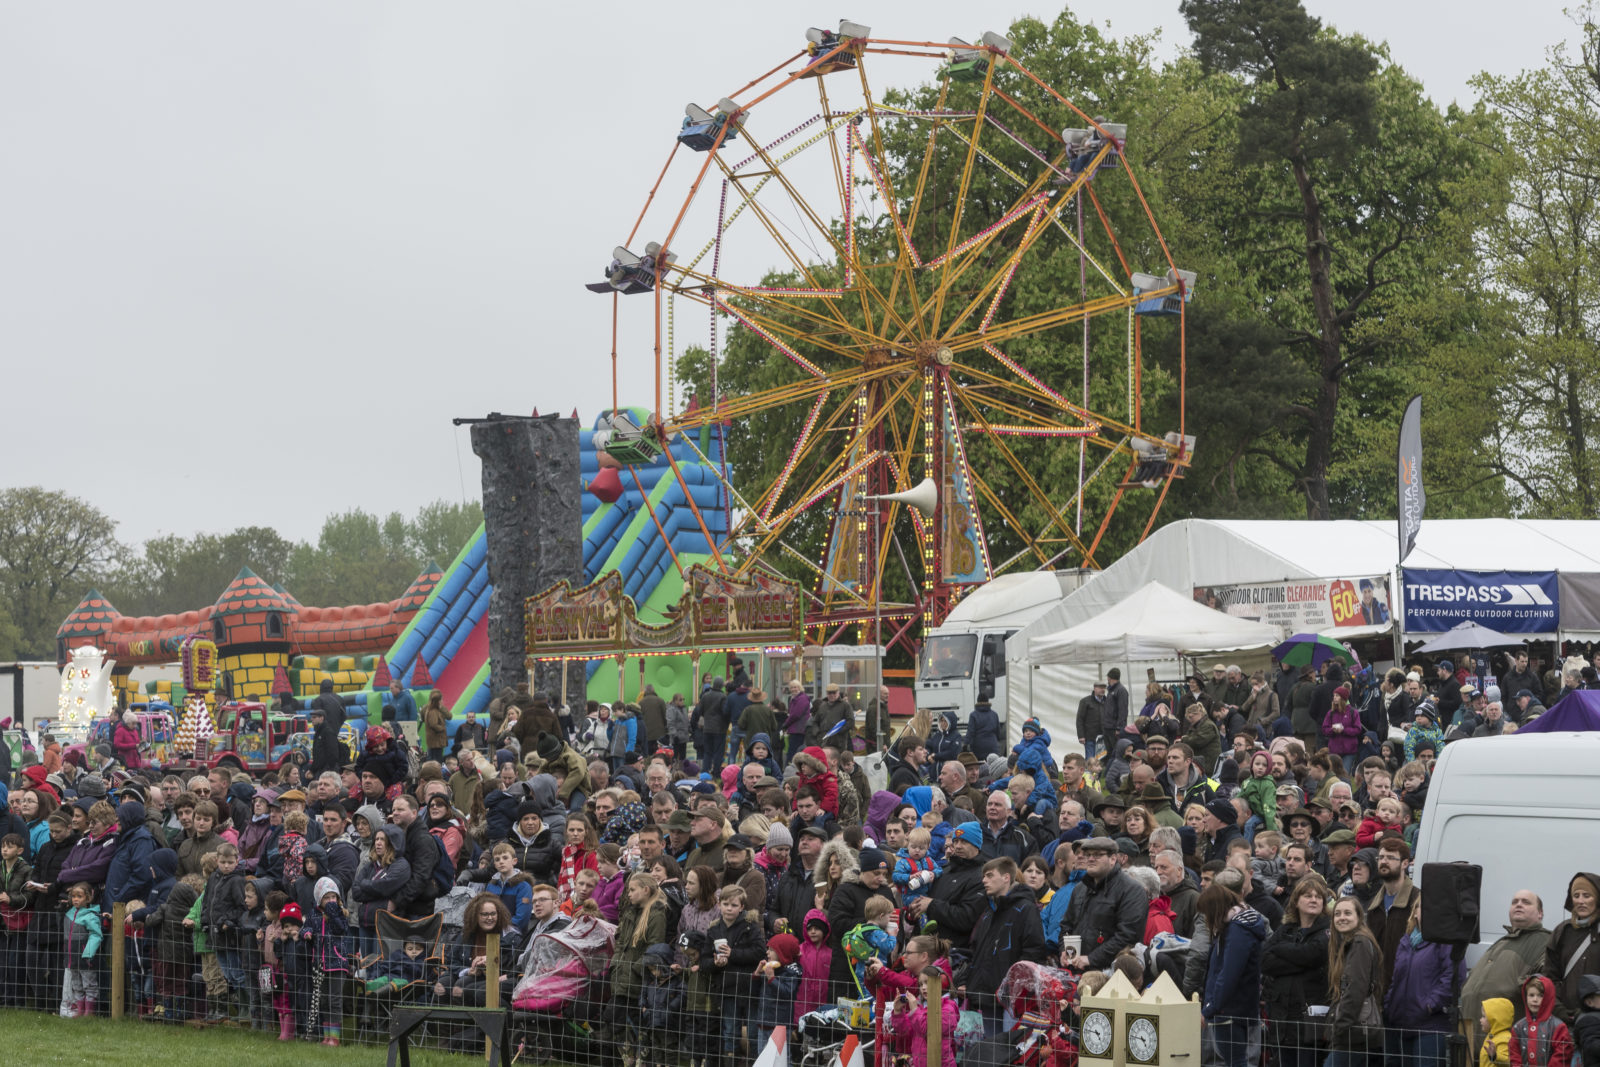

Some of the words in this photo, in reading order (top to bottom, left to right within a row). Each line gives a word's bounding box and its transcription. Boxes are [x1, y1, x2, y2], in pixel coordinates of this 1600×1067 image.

[1252, 586, 1285, 604] CLOTHING
[1286, 584, 1327, 603] CLEARANCE
[1406, 584, 1502, 602] TRESPASS
[1407, 608, 1471, 618] PERFORMANCE
[1474, 609, 1512, 618] OUTDOOR
[1514, 609, 1554, 618] CLOTHING
